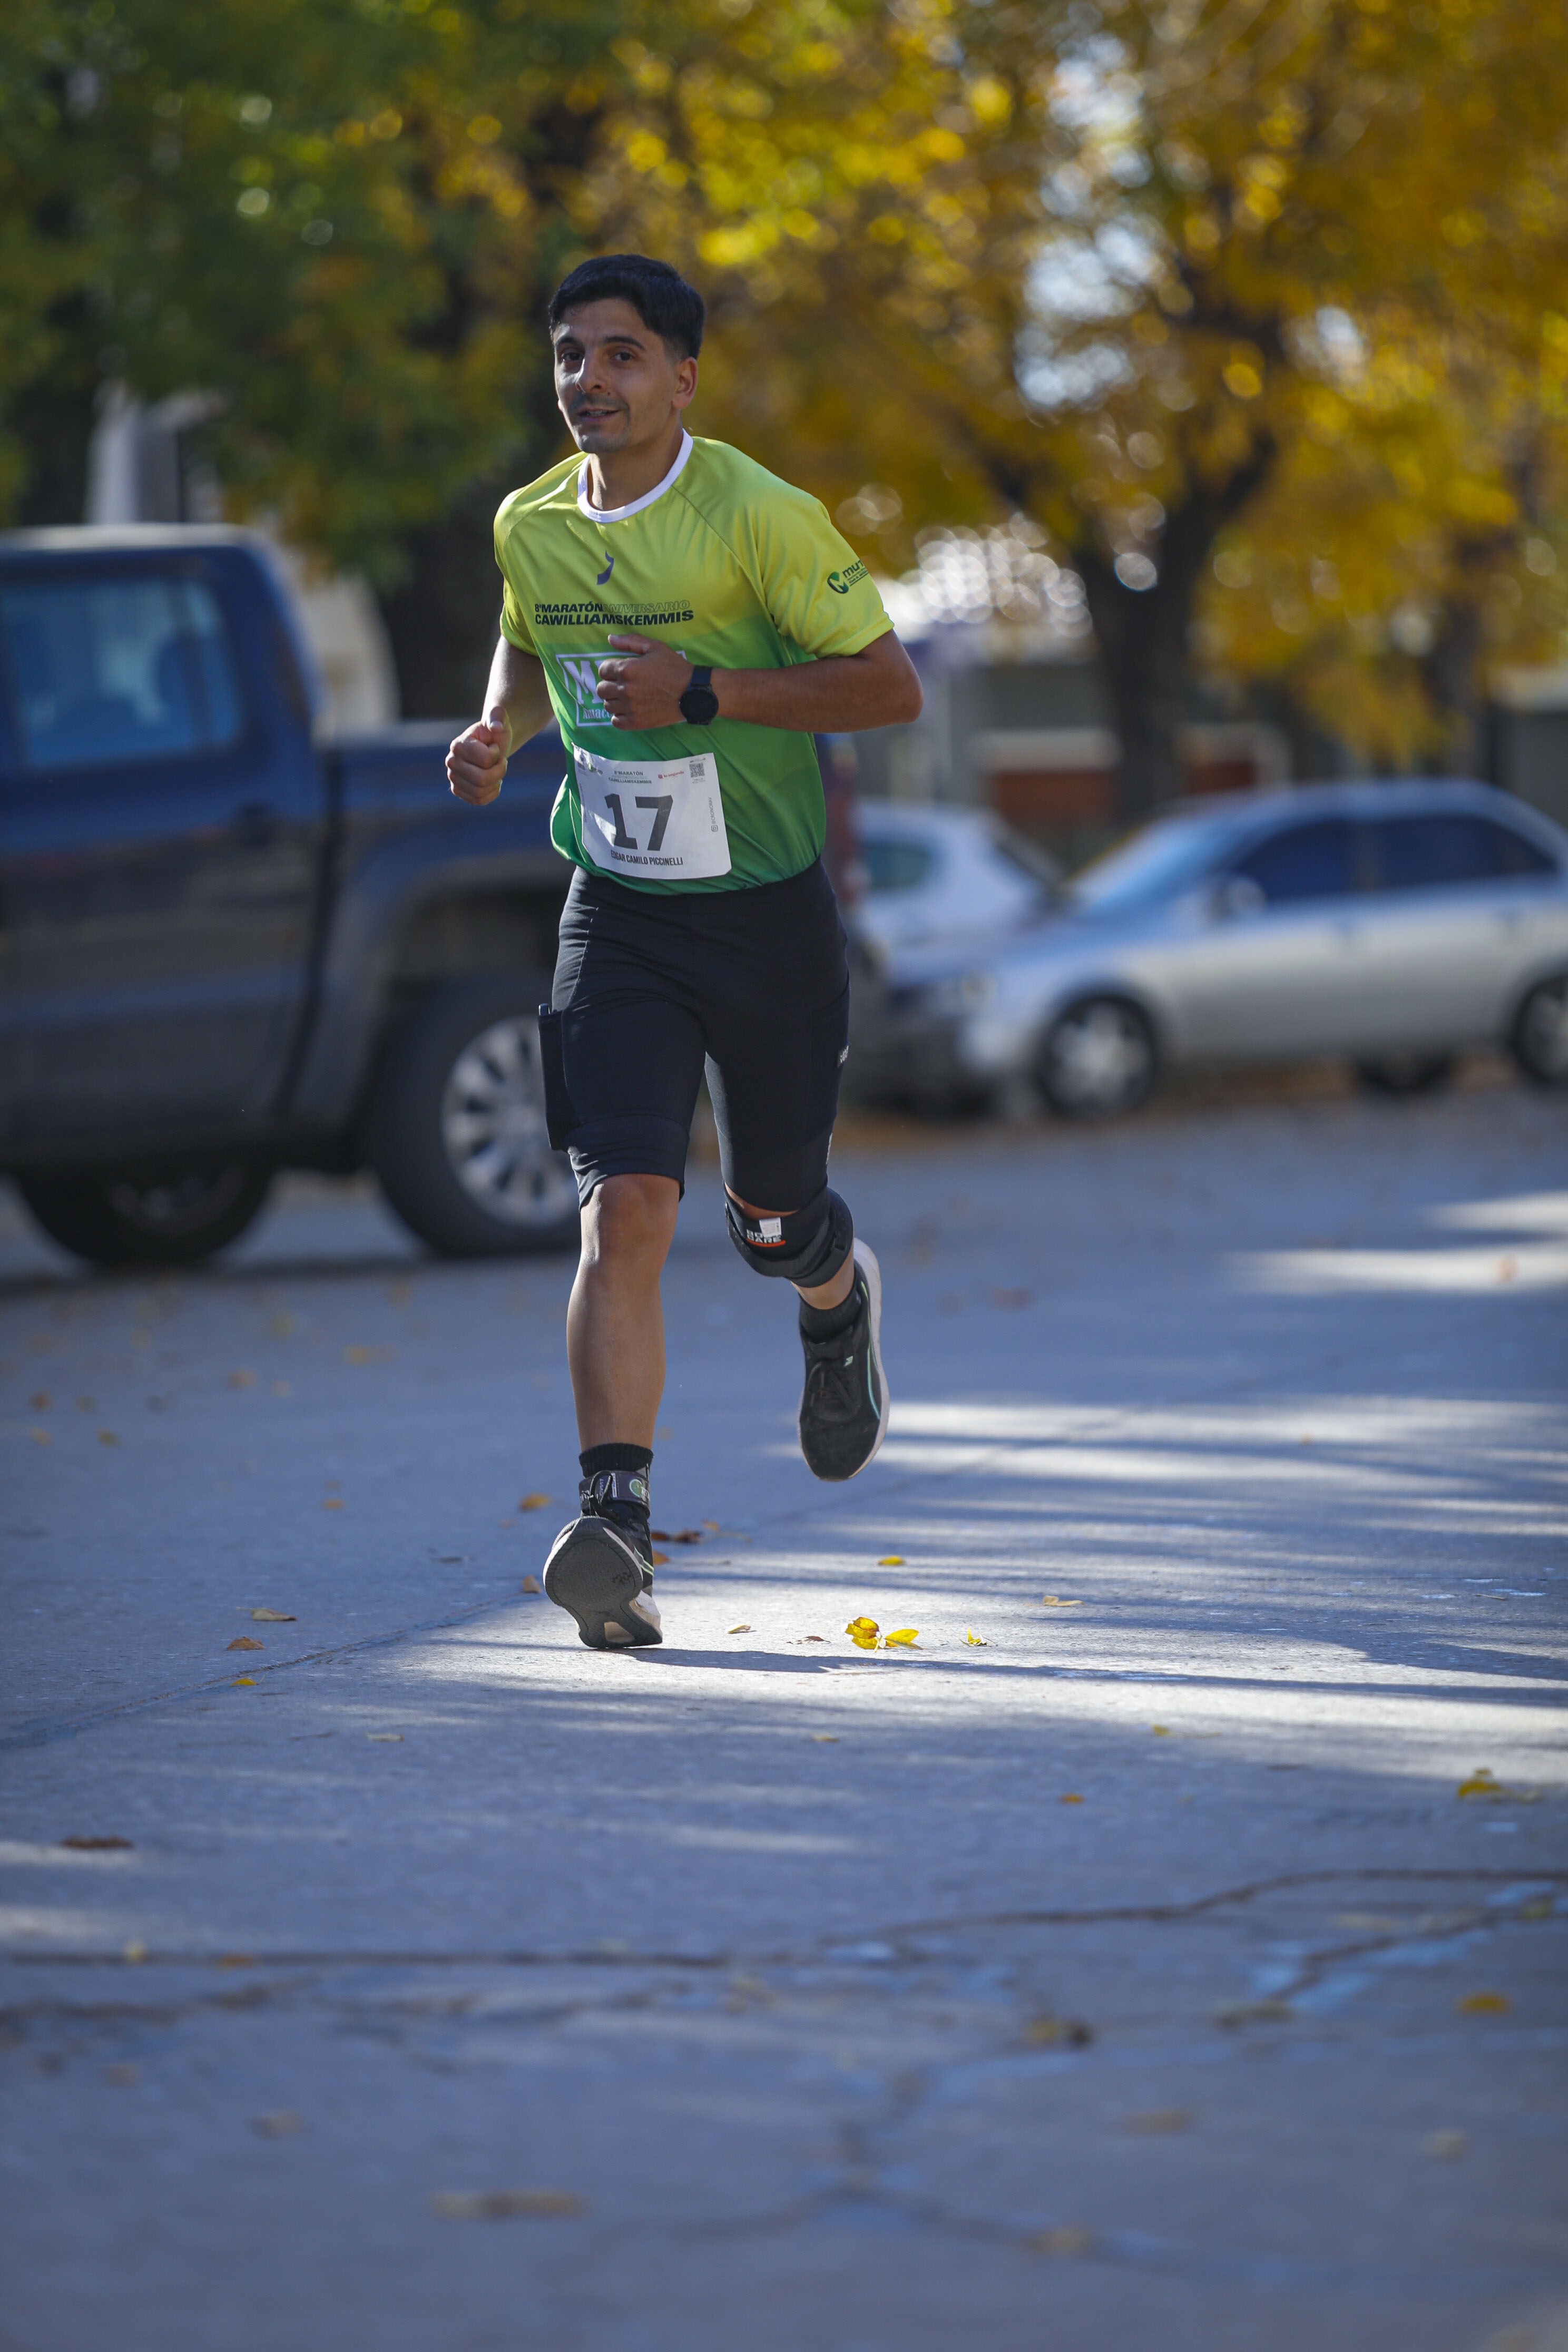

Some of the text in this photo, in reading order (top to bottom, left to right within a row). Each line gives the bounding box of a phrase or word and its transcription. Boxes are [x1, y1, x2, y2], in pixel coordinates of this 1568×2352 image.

[535, 610, 694, 625] CAWILLIAMSKEMMIS
[604, 793, 673, 851] 17
[611, 849, 683, 866] EDGAR CAMILO PICCINELLI
